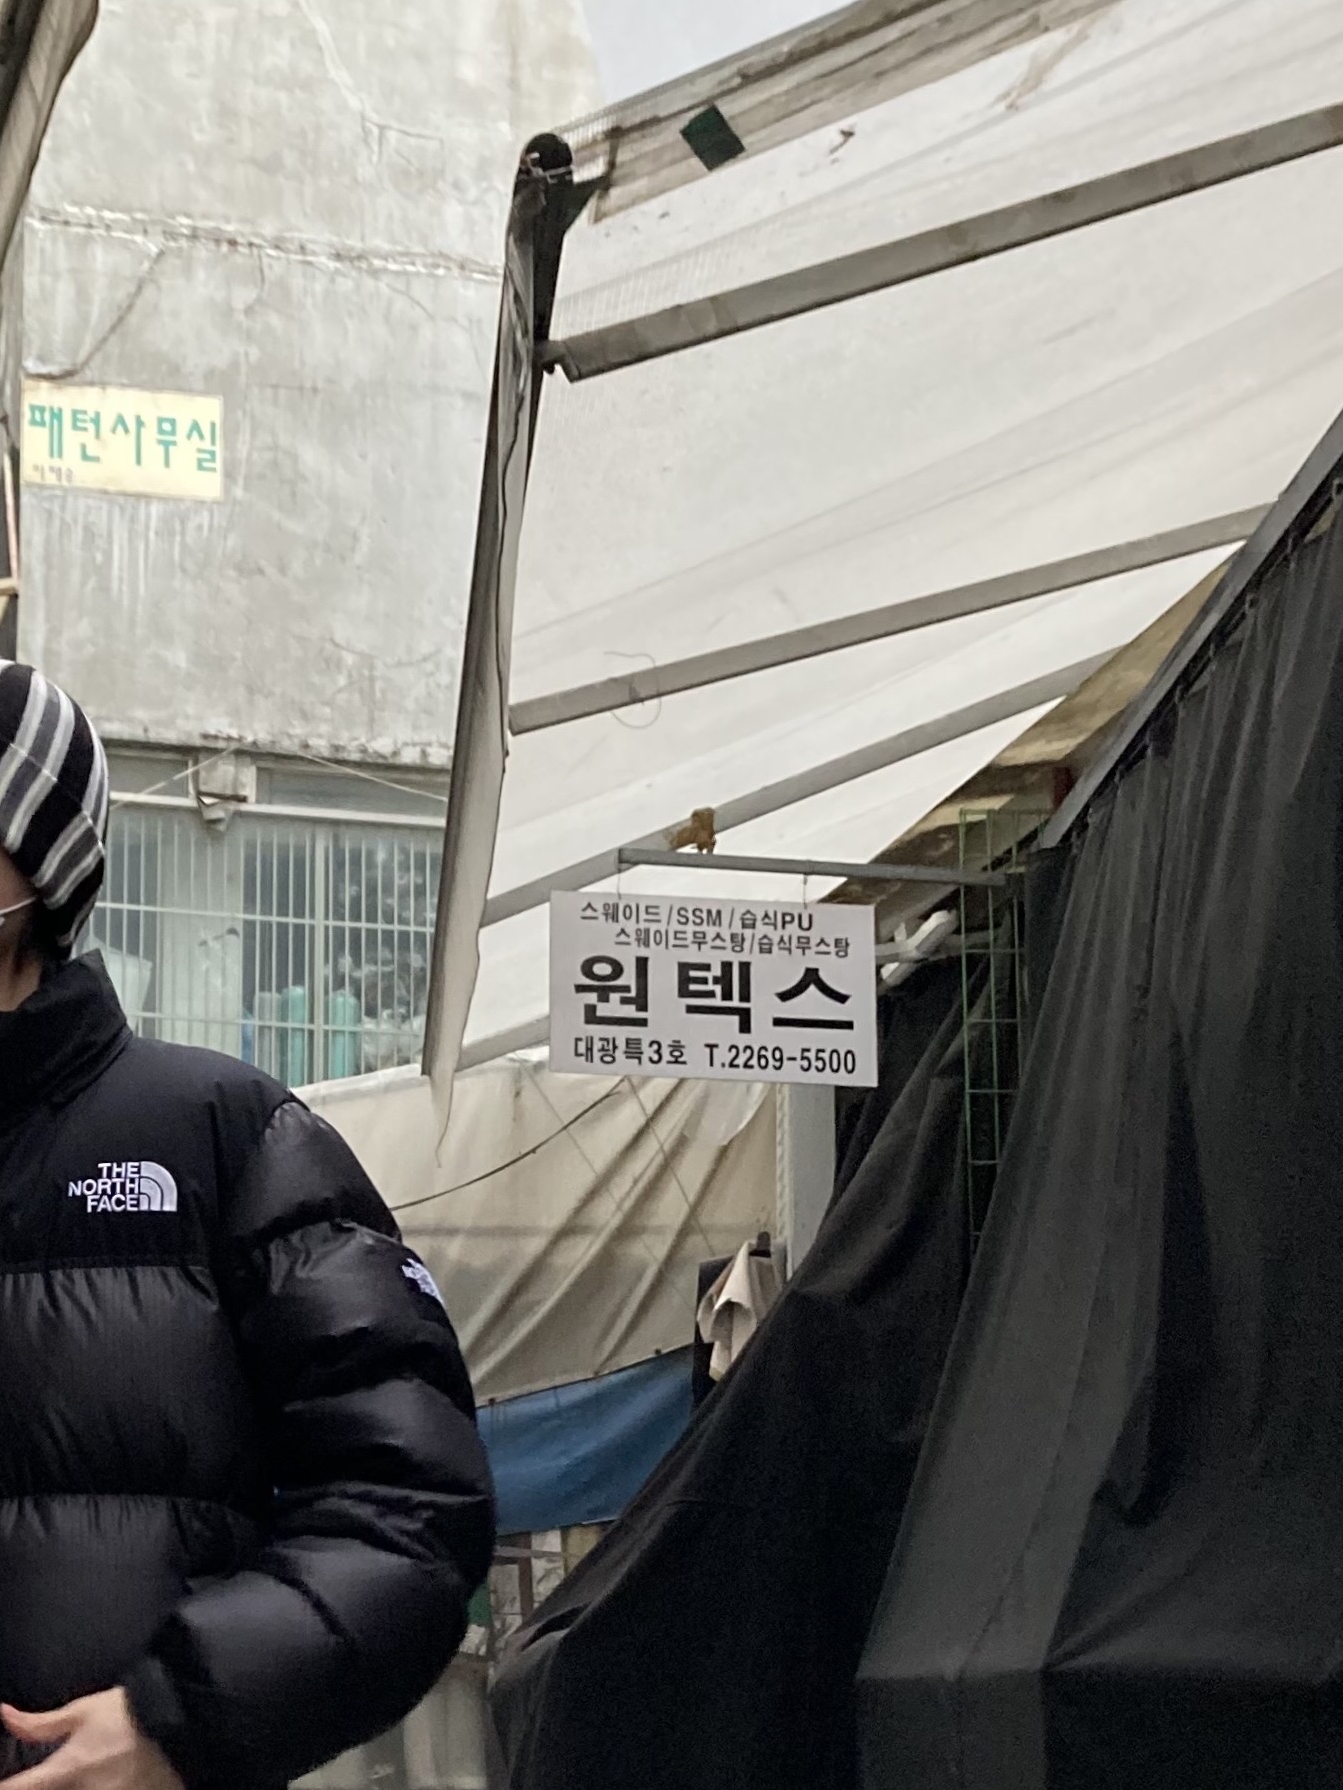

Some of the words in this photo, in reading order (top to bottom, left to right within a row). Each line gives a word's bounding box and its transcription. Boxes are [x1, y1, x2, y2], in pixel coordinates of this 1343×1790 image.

[28, 403, 218, 473] 패턴사무실
[573, 954, 855, 1035] 원텍스
[574, 1035, 688, 1068] 대광특3호
[704, 1042, 857, 1075] T.2269-5500
[97, 1161, 140, 1179] THE
[68, 1178, 139, 1197] NORTH
[87, 1194, 139, 1213] FACE
